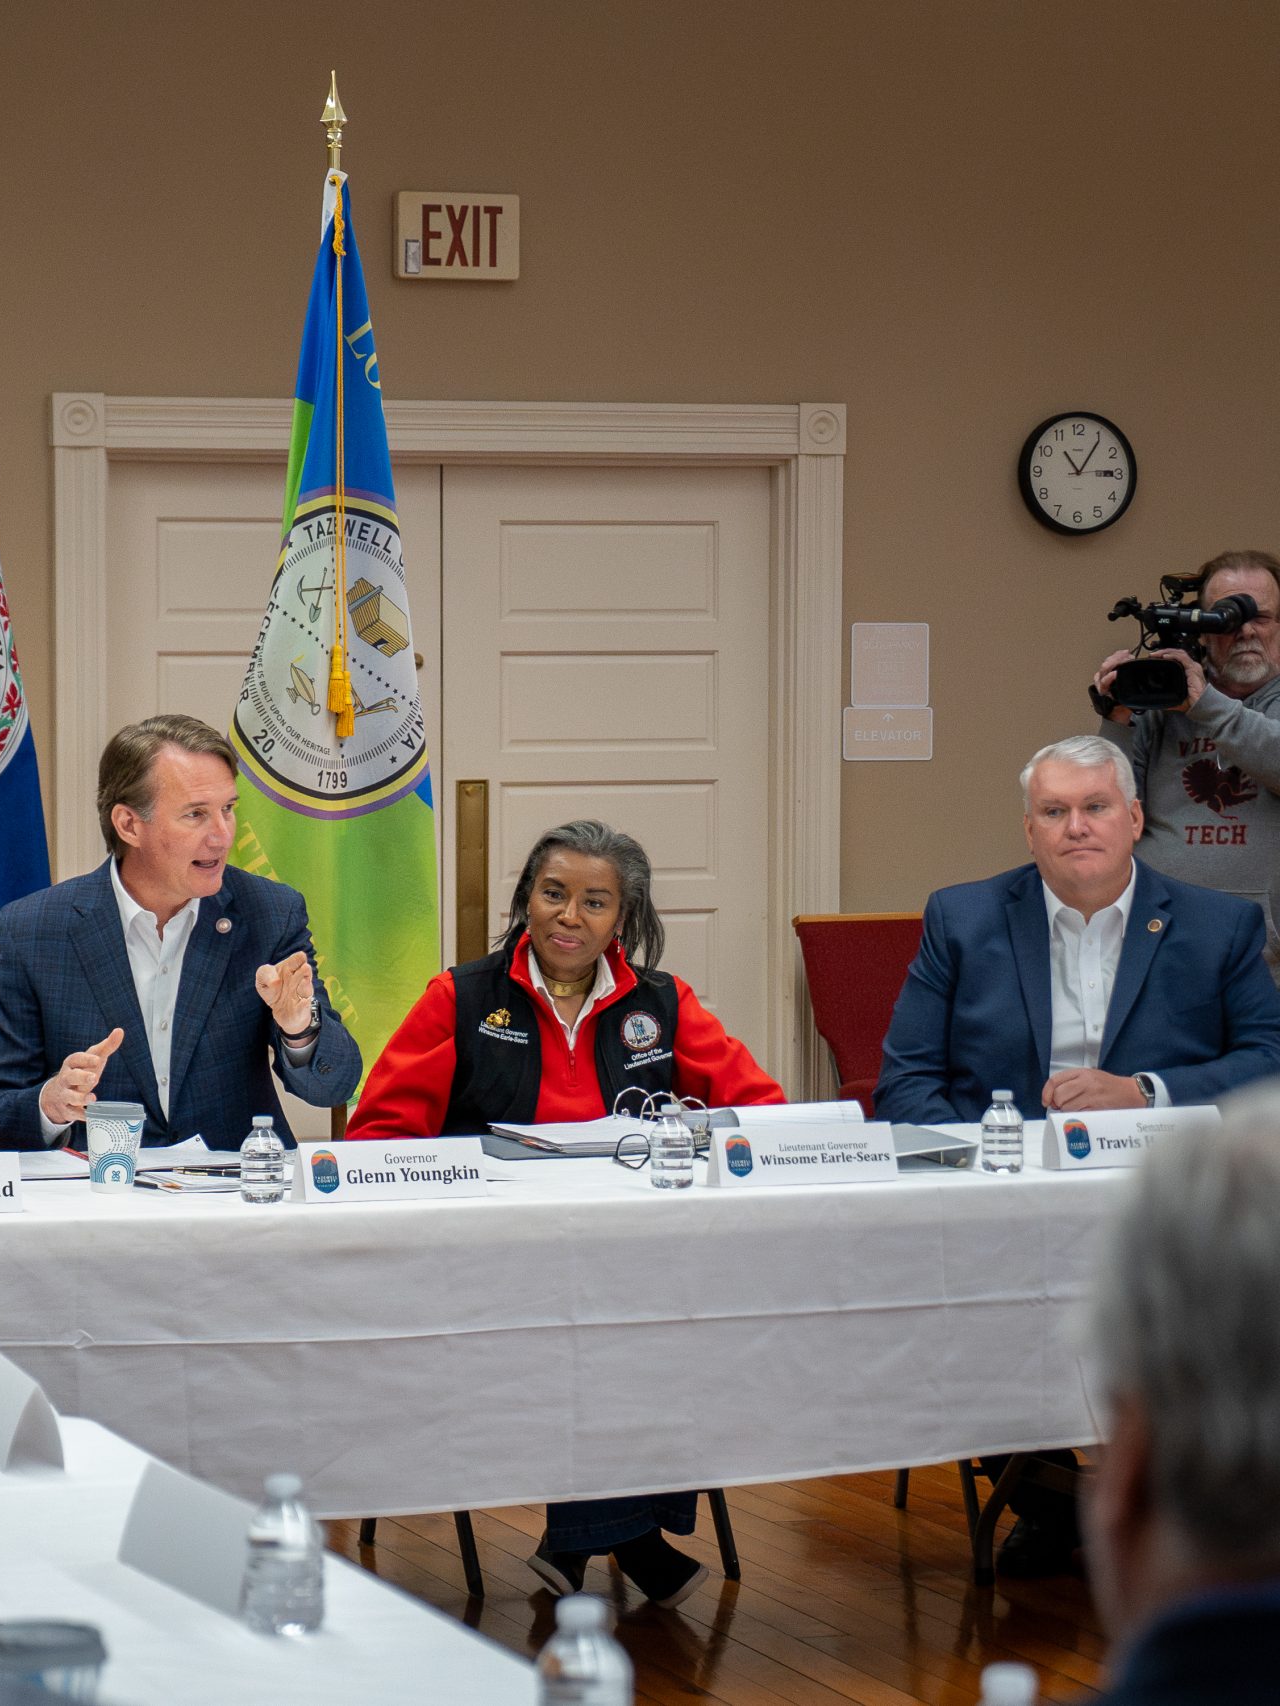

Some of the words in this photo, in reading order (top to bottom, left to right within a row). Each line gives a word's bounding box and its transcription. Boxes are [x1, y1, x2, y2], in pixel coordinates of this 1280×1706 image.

[421, 203, 503, 268] EXIT
[1054, 429, 1064, 441] 11
[1072, 424, 1085, 436] 12
[1096, 431, 1100, 441] 1
[1039, 445, 1053, 457] 10
[1108, 447, 1117, 459] 2
[1033, 466, 1042, 478] 9
[1114, 468, 1123, 480] 3
[1039, 488, 1048, 500] 8
[1108, 491, 1116, 502] 4
[1054, 505, 1062, 516] 7
[1093, 506, 1102, 518] 5
[1073, 511, 1082, 523] 6
[259, 680, 273, 703] BUILT
[270, 704, 287, 727] UPON
[286, 726, 302, 740] OUR
[301, 737, 331, 756] HERITAGE
[854, 729, 922, 741] ELEVATOR
[317, 770, 348, 790] 1799
[1184, 824, 1247, 845] TECH
[631, 1052, 647, 1061] Office
[624, 1058, 652, 1070] Lieutenant
[779, 1143, 826, 1152] Lieutenant
[827, 1141, 868, 1150] Governor
[1096, 1136, 1141, 1150] Travis
[384, 1152, 438, 1164] Governor
[760, 1154, 817, 1166] Winsome
[821, 1151, 890, 1164] Earle-Sears
[346, 1169, 396, 1184] Glenn
[400, 1165, 480, 1184] Youngkin
